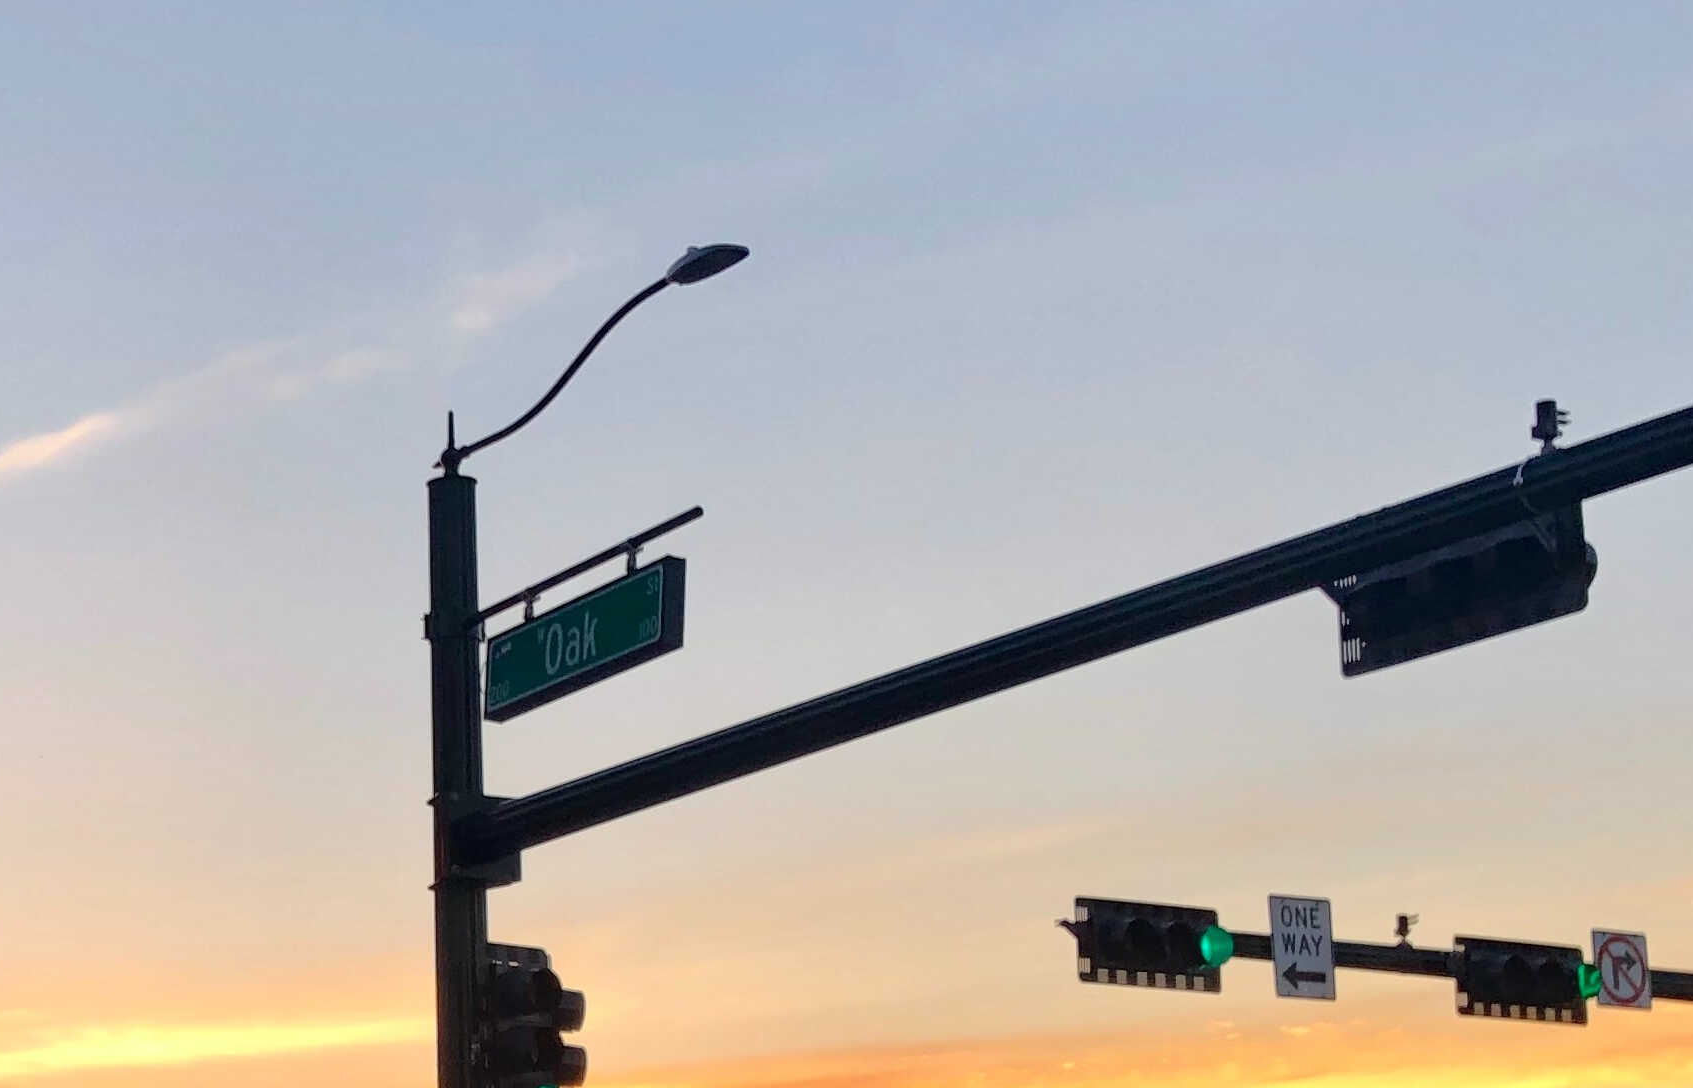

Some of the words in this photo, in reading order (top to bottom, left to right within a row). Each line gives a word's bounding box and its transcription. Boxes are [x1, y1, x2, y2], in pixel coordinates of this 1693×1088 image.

[545, 611, 598, 675] Oak
[1280, 904, 1321, 929] ONE
[1281, 932, 1324, 957] WAY
